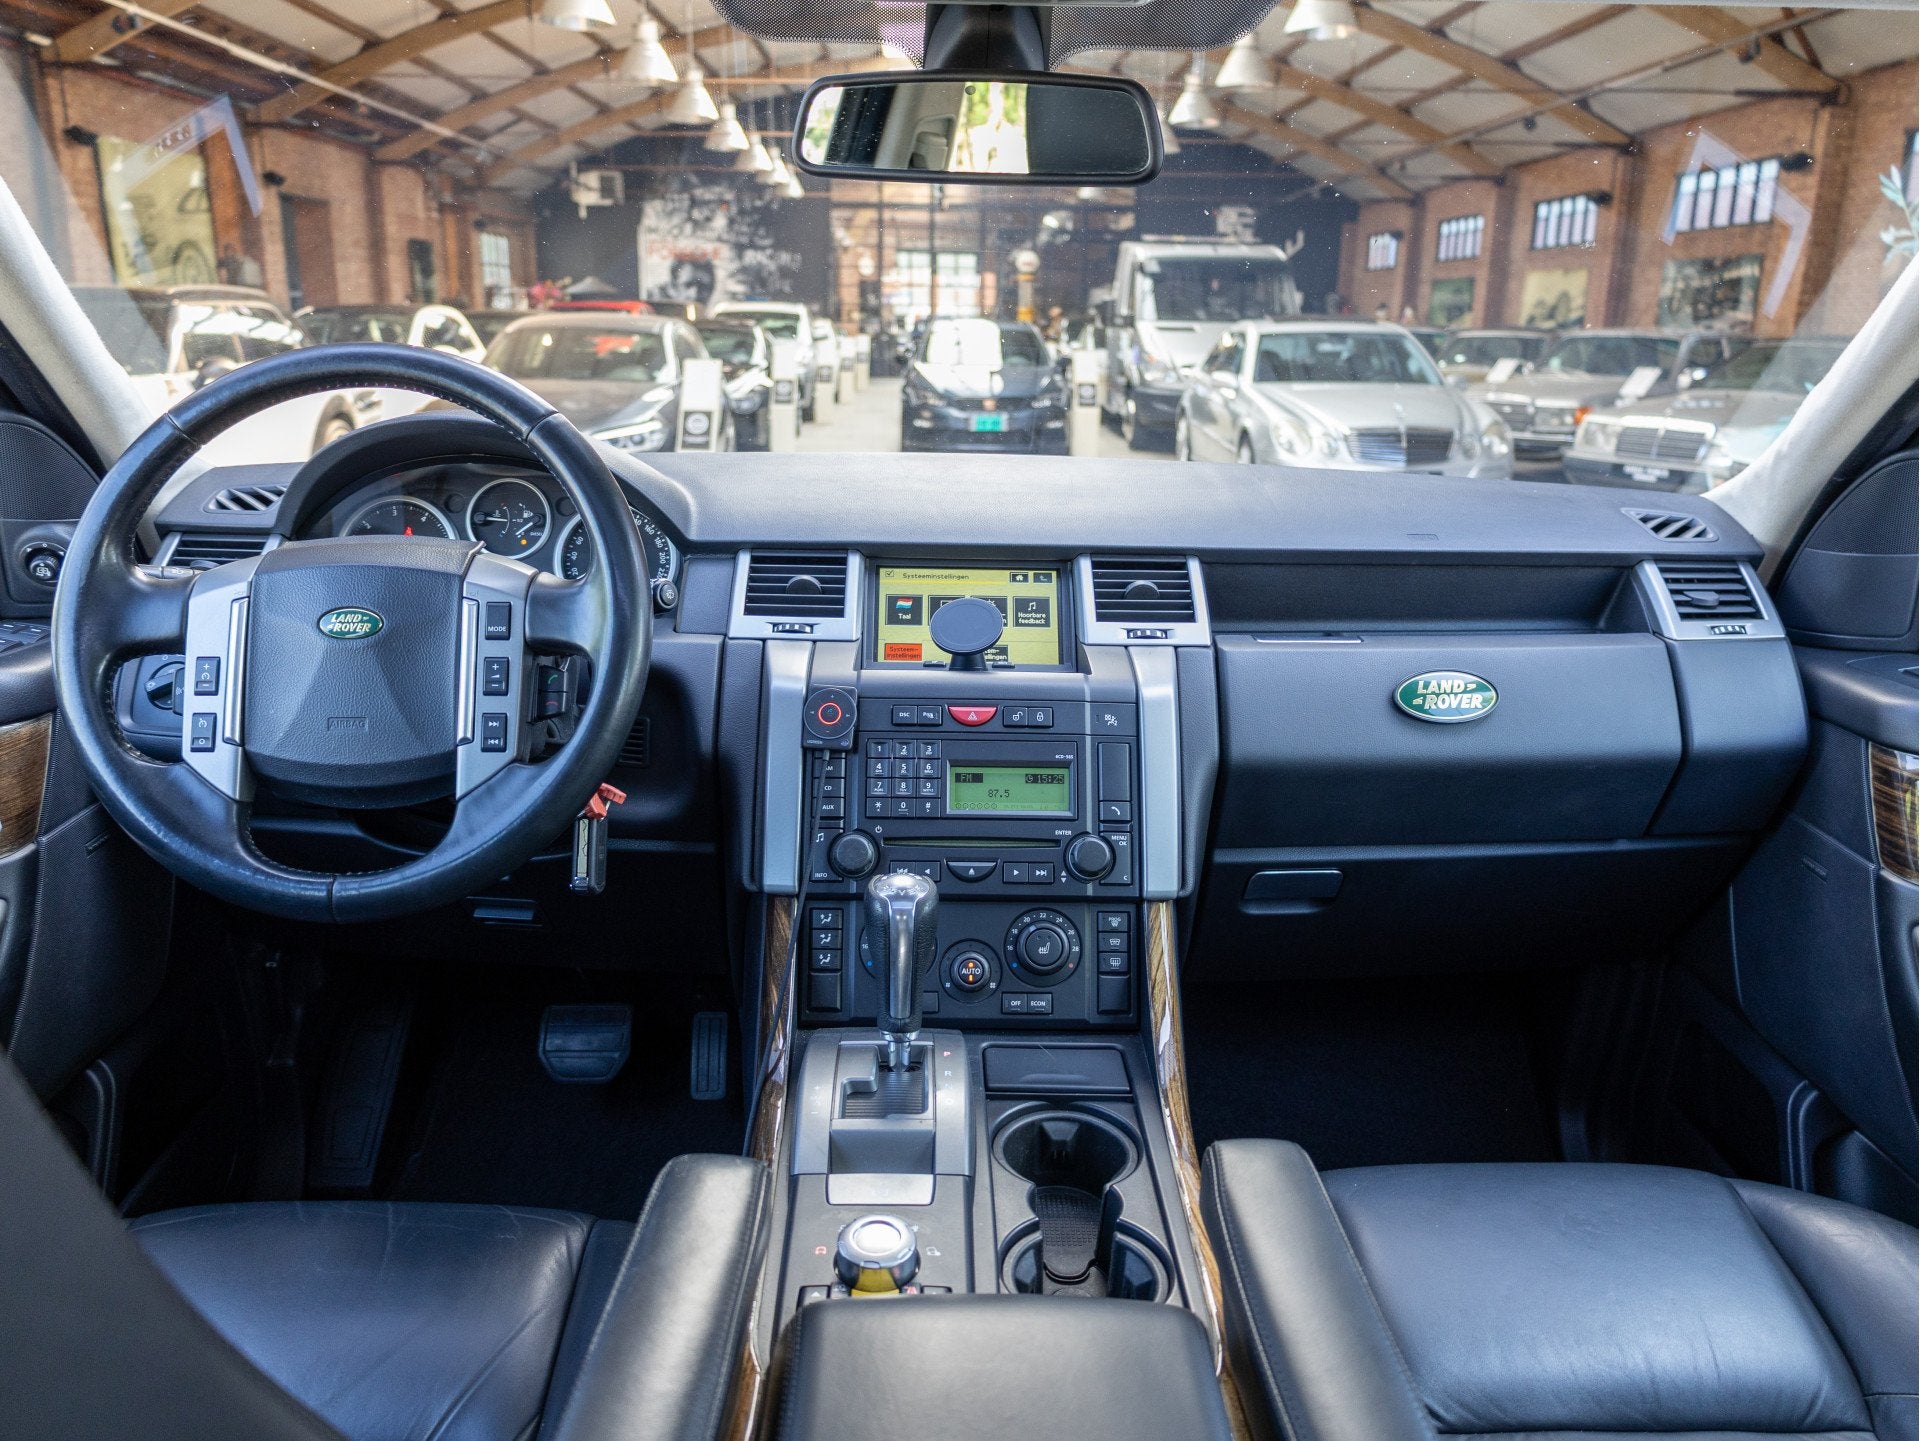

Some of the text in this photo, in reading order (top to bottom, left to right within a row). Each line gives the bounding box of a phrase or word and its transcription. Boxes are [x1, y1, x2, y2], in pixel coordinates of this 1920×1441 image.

[644, 524, 655, 536] 160
[576, 536, 584, 546] 60
[654, 537, 664, 548] 180
[570, 552, 578, 560] 40
[571, 567, 579, 576] 20
[902, 572, 970, 580] Systeeminstellingen
[330, 614, 362, 622] LAND
[333, 622, 372, 632] ROVER
[1417, 680, 1466, 694] LAND
[1424, 694, 1484, 710] ROVER
[960, 774, 972, 782] FM
[1037, 774, 1064, 784] 15:25
[988, 789, 1010, 798] 87.5
